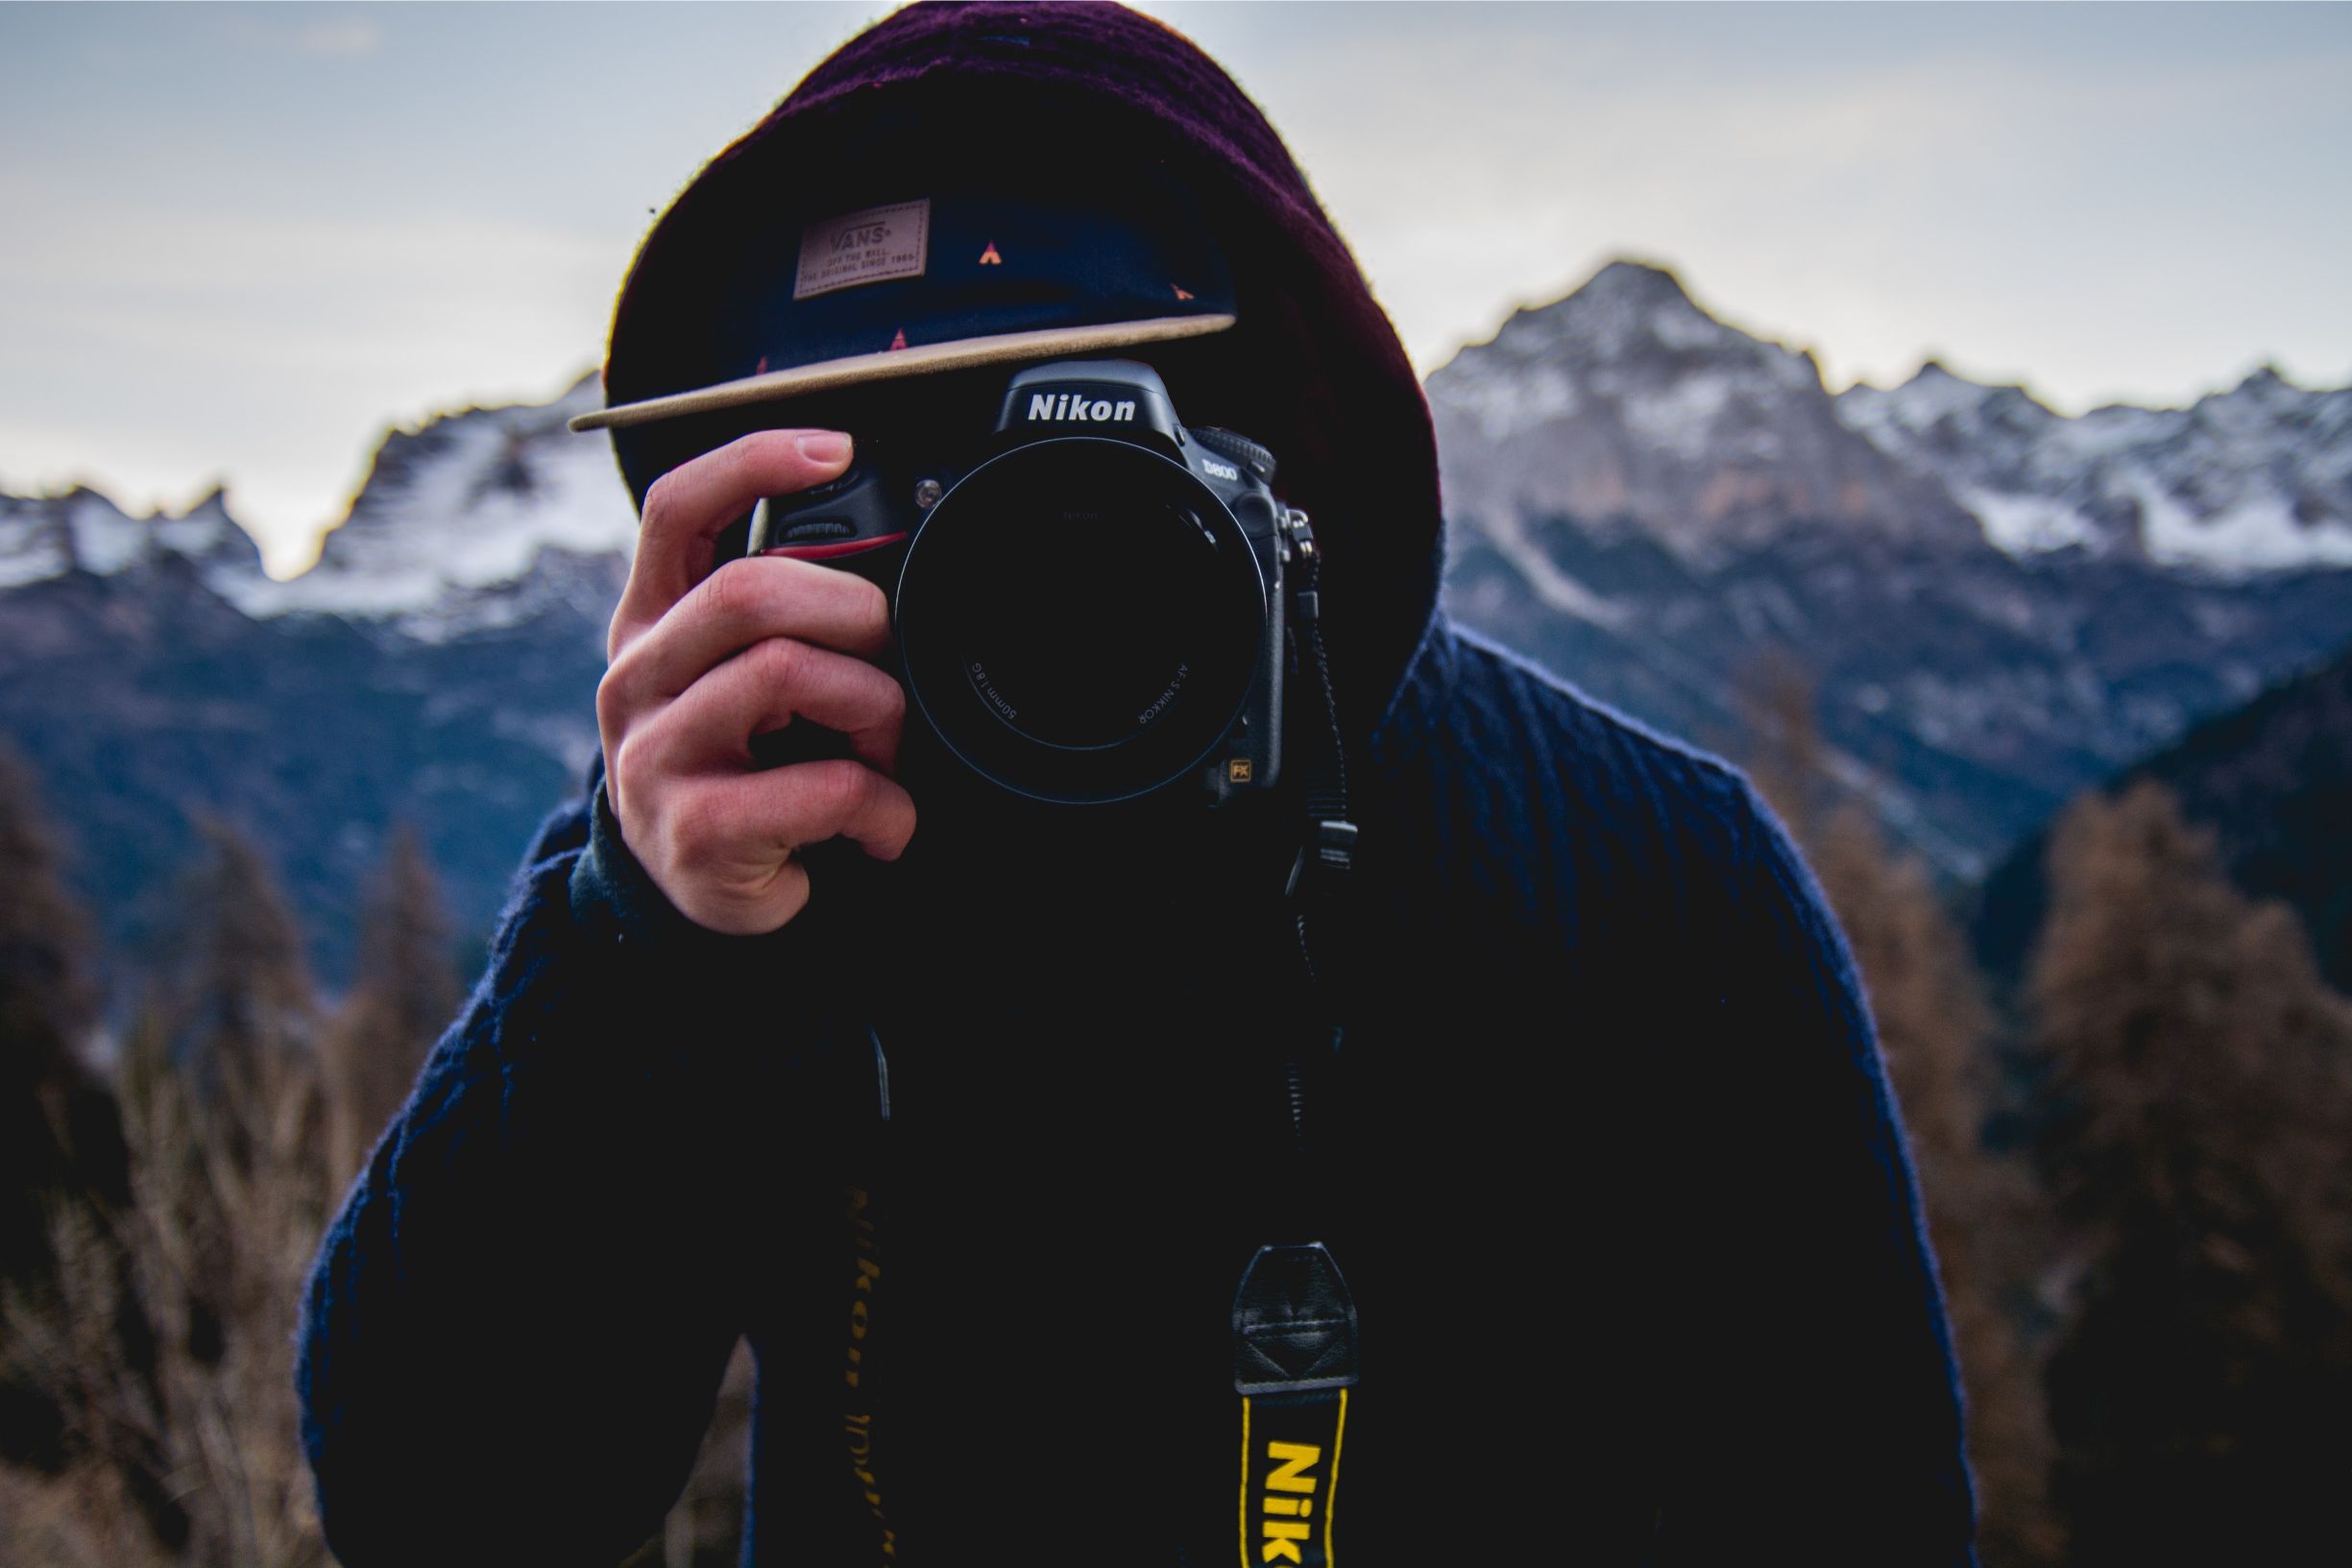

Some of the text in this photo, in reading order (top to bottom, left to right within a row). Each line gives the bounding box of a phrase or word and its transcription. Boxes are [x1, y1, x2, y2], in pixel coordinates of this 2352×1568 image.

[1028, 394, 1136, 422] Nikon
[985, 687, 1018, 720] 50mm
[1137, 689, 1176, 724] NIKKOR
[1262, 1441, 1321, 1568] Nik
